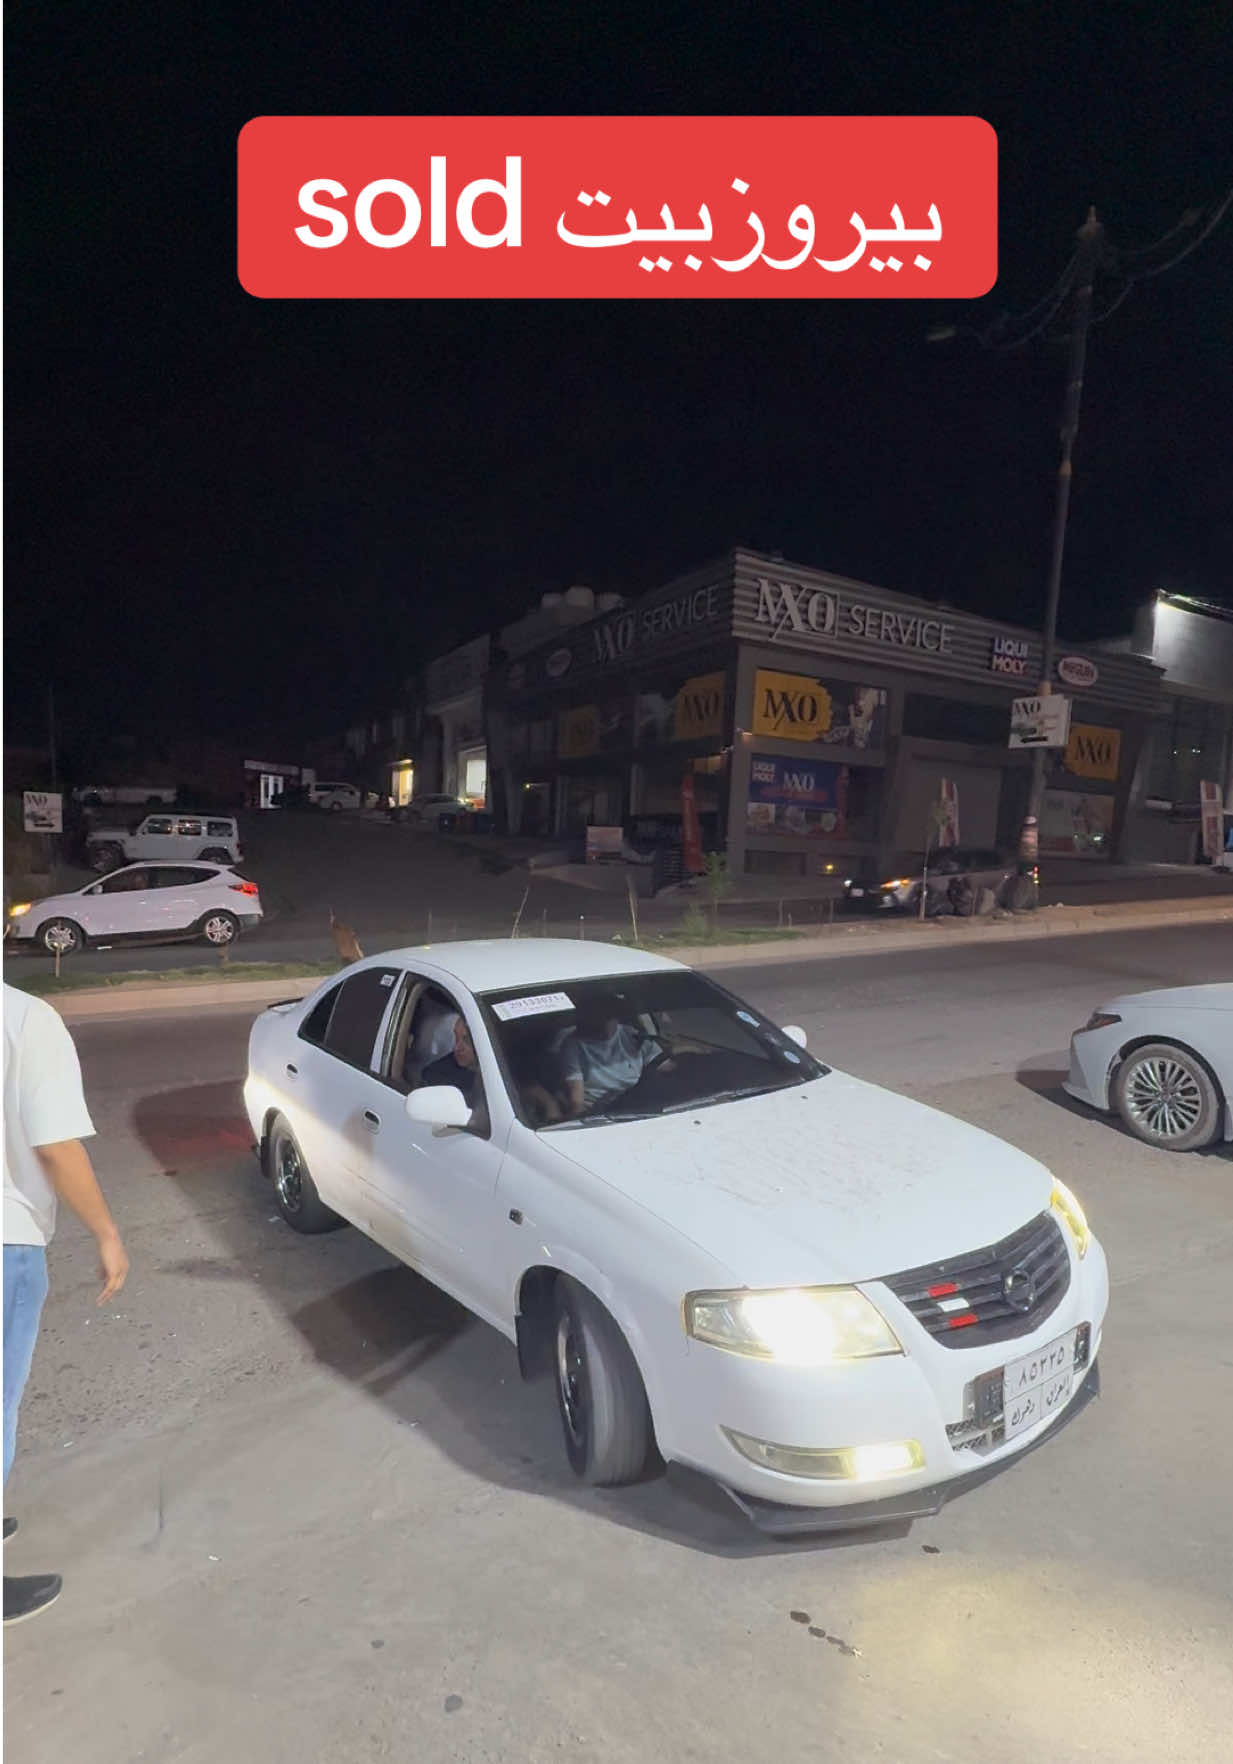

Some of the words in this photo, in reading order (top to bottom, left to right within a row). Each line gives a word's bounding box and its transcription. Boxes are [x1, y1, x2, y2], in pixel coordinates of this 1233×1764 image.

[641, 584, 720, 636] SERVICE
[848, 603, 955, 655] SERVICE
[993, 637, 1029, 658] LIQUI
[992, 654, 1027, 676] MOLY
